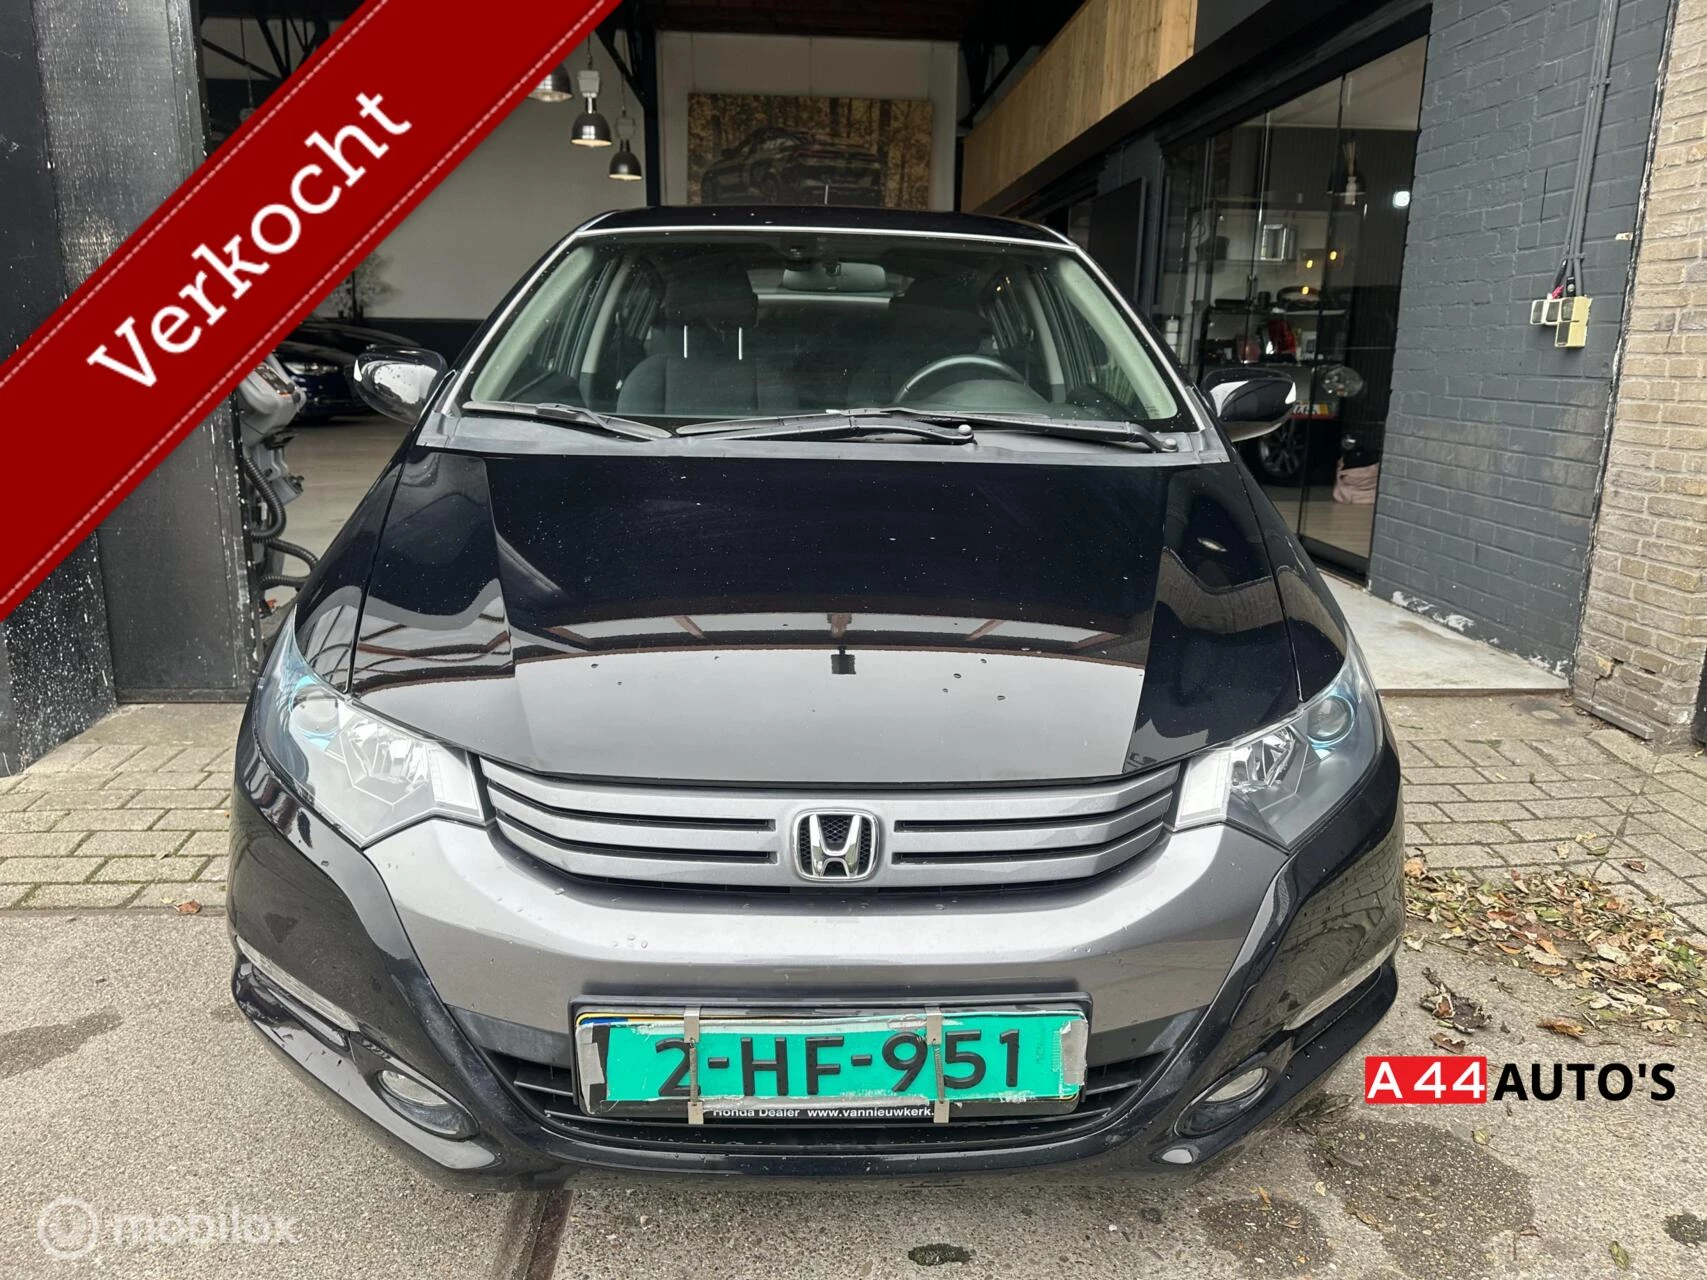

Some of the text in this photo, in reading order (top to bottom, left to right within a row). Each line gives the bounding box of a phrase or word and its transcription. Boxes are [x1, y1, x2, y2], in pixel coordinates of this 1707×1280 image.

[655, 1029, 1020, 1097] 2-HF-951
[713, 1108, 755, 1117] Honda
[758, 1108, 800, 1117] Dealer
